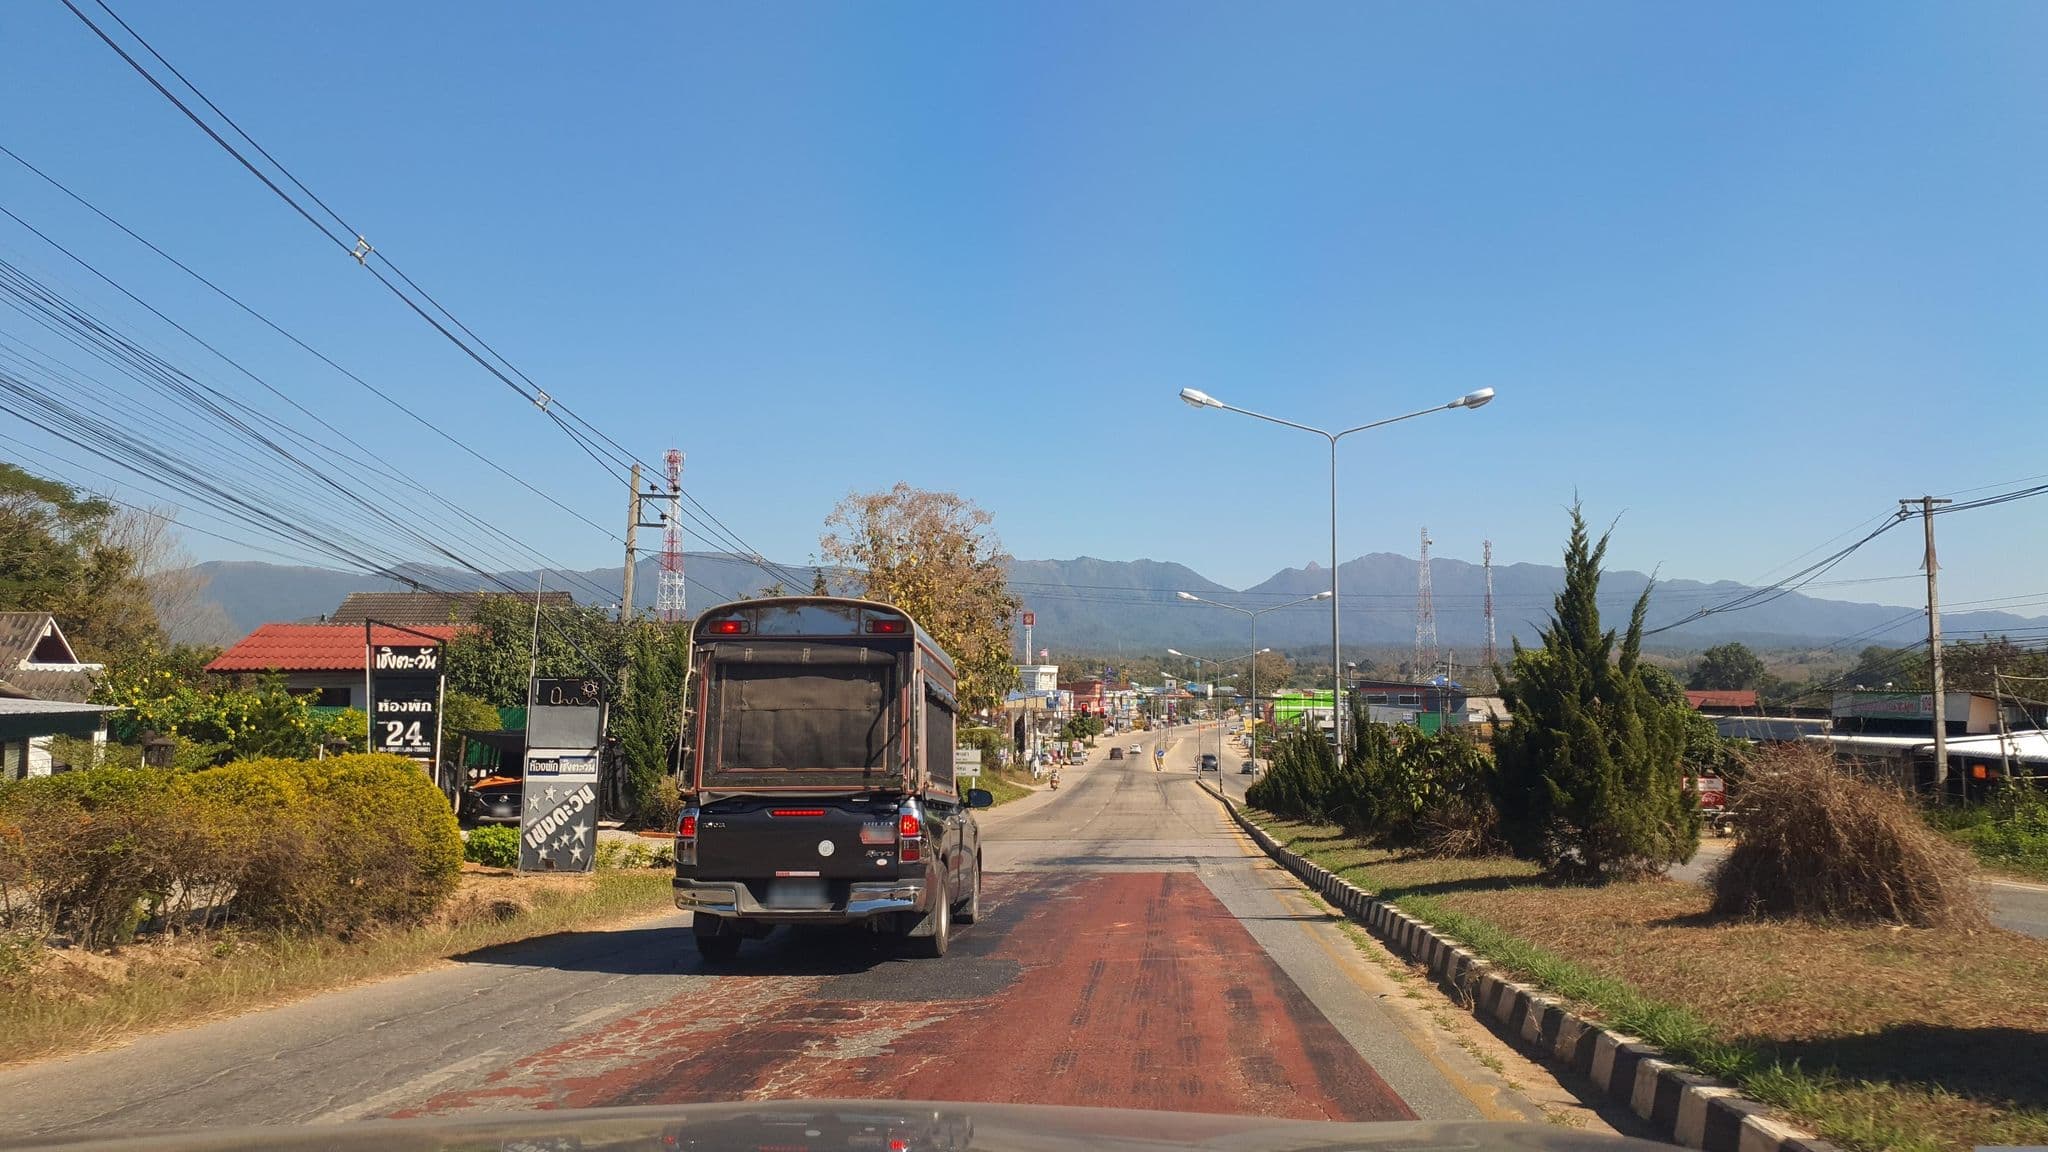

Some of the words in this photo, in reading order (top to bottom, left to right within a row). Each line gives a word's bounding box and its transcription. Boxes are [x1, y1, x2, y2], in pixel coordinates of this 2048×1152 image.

[376, 646, 437, 669] เชิงตะวัน
[378, 699, 432, 712] ห้องพัก
[386, 720, 422, 746] 24
[529, 760, 558, 772] ห้องพัก
